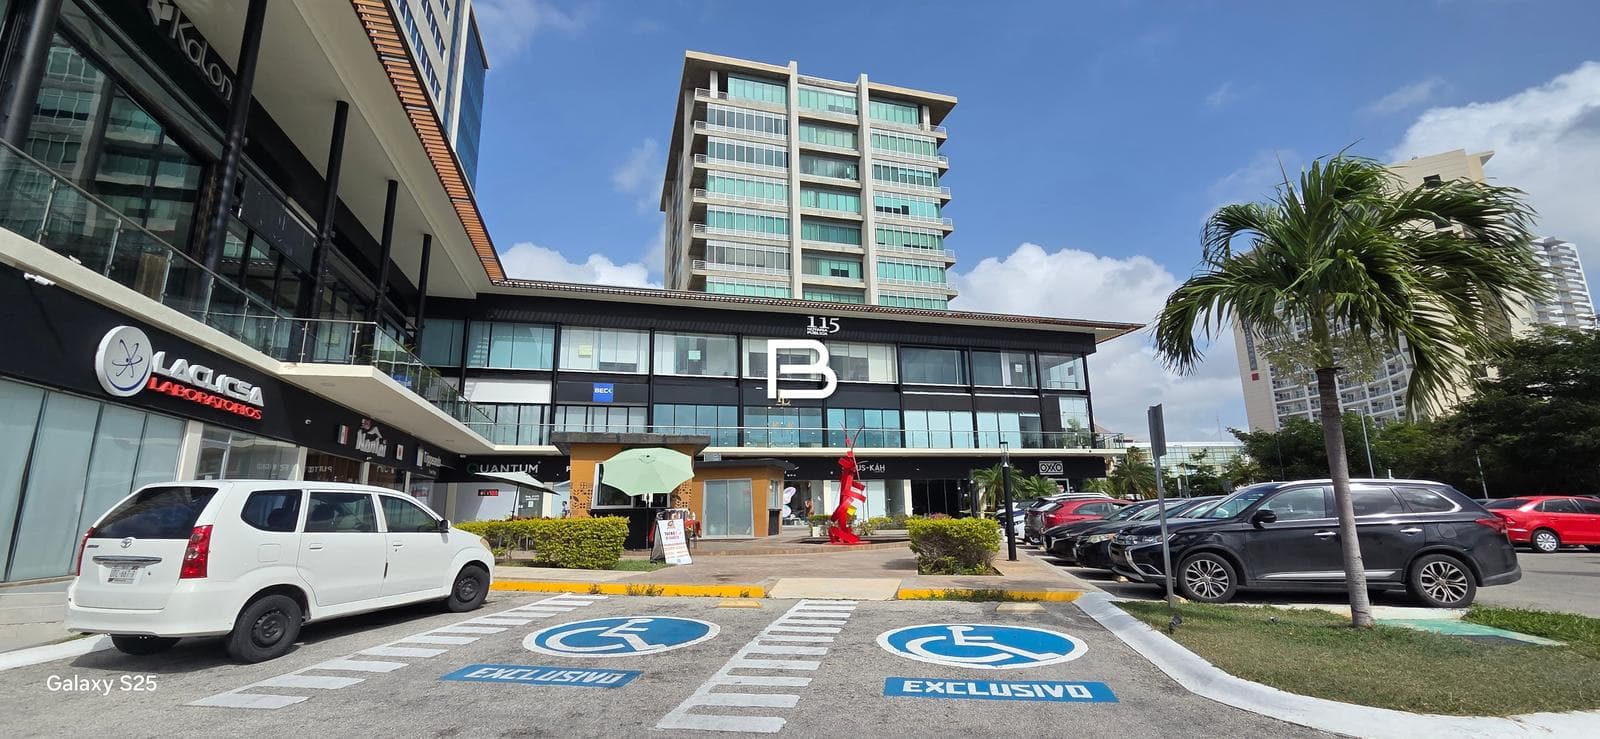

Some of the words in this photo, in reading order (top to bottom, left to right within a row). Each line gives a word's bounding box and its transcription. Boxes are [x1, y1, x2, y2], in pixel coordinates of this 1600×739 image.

[169, 8, 233, 101] Kalon
[807, 316, 840, 333] 115
[152, 351, 264, 407] LACLICSA
[147, 377, 263, 420] LABORATORIOS
[467, 463, 539, 475] QUANTUM
[1040, 462, 1063, 473] OXXO
[464, 667, 626, 684] EXCLUSIVO
[903, 680, 1093, 699] EXCLUSIVO
